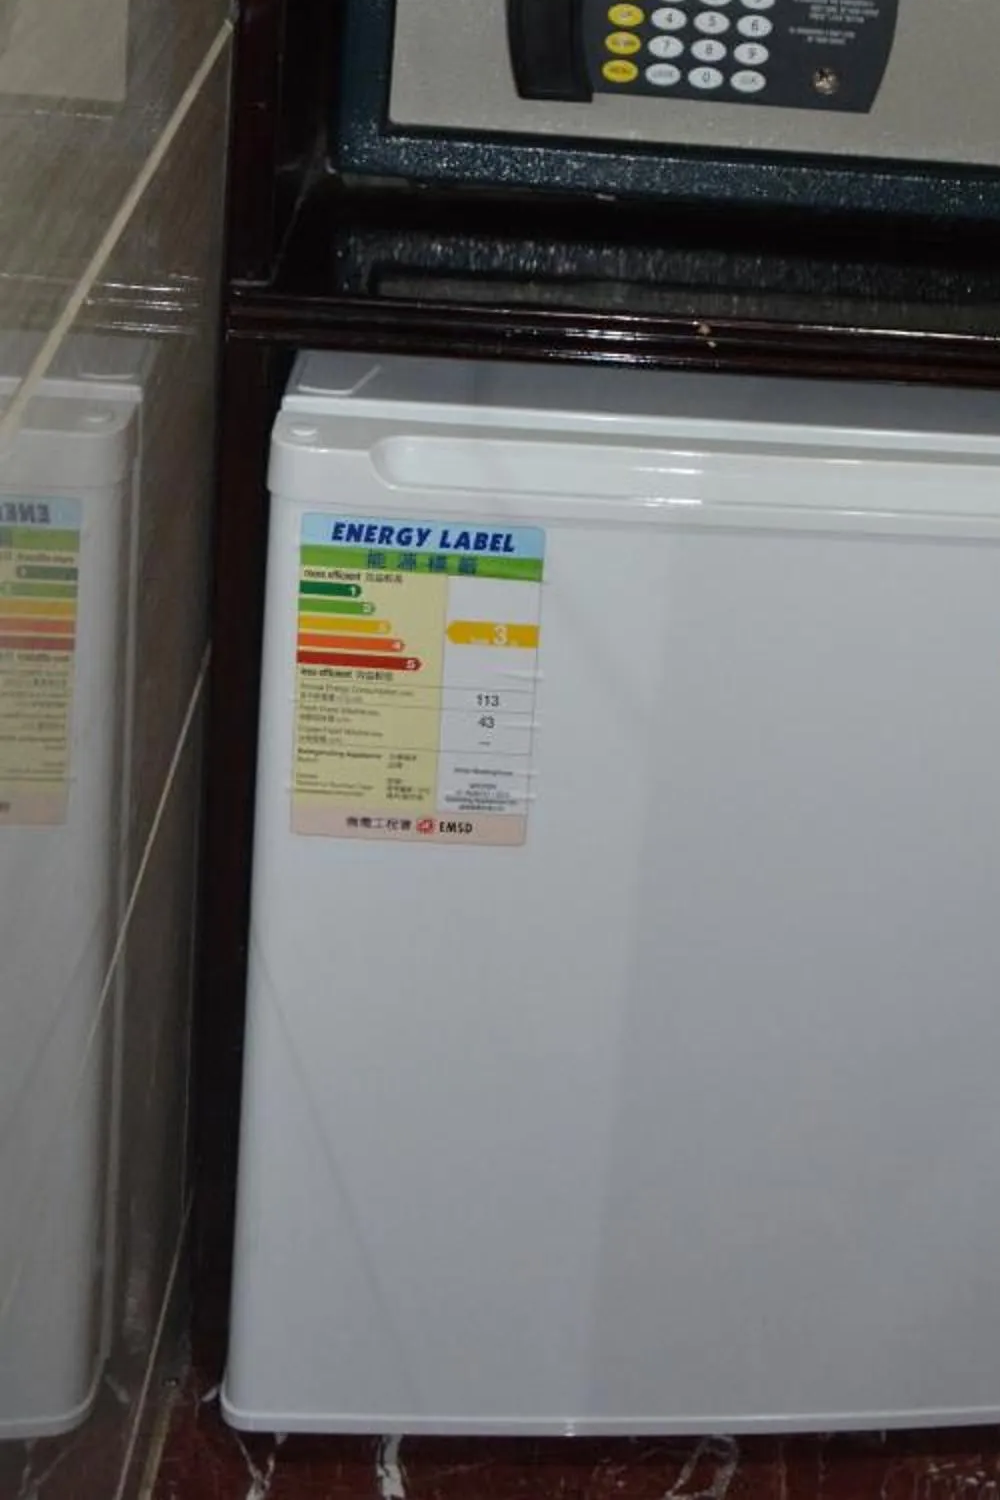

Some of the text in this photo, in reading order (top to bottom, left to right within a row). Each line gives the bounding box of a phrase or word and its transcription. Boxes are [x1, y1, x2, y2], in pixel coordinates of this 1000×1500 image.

[331, 521, 516, 553] ENERGY LABEL
[493, 624, 507, 646] 3
[476, 694, 500, 708] 113
[478, 715, 496, 729] 43
[439, 820, 473, 834] EMSD
